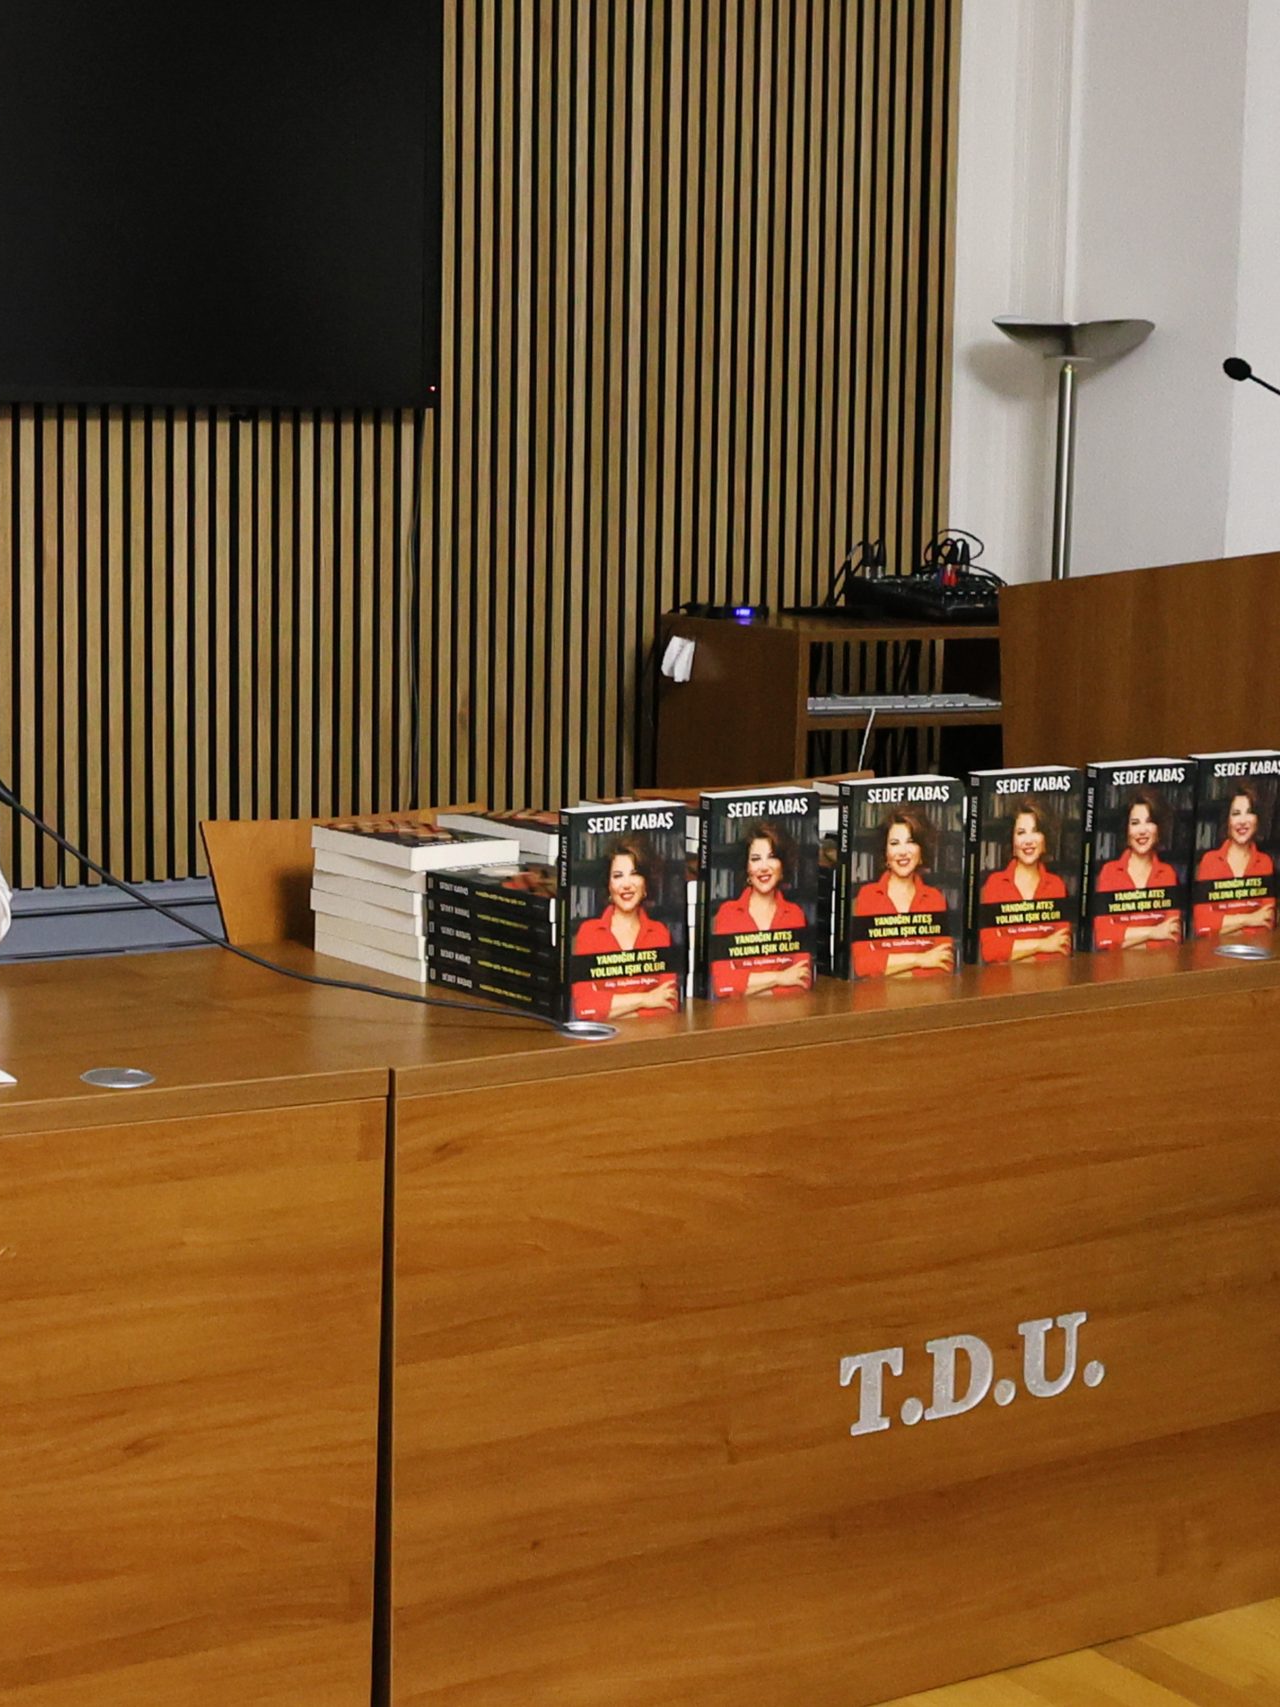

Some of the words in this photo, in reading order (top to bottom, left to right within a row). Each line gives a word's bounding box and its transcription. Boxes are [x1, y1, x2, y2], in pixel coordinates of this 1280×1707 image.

[1113, 770, 1146, 785] SEDEF
[1148, 767, 1185, 783] KABAŞ
[1214, 762, 1248, 777] SEDEF
[996, 778, 1031, 794] SEDEF
[1033, 775, 1070, 792] KABAŞ
[867, 787, 905, 803] SEDEF
[908, 786, 949, 802] KABAŞ
[727, 801, 766, 818] SEDEF
[769, 797, 808, 815] KABAŞ
[588, 816, 628, 833] SEDEF
[631, 812, 673, 830] KABAŞ
[874, 914, 911, 926] YANDIĞIN
[912, 914, 932, 925] ATEŞ
[735, 932, 771, 944] YANDIĞIN
[773, 931, 792, 941] ATEŞ
[596, 952, 635, 965] YANDIĞIN
[637, 951, 657, 961] ATEŞ
[839, 1311, 1105, 1436] T.D.U.
